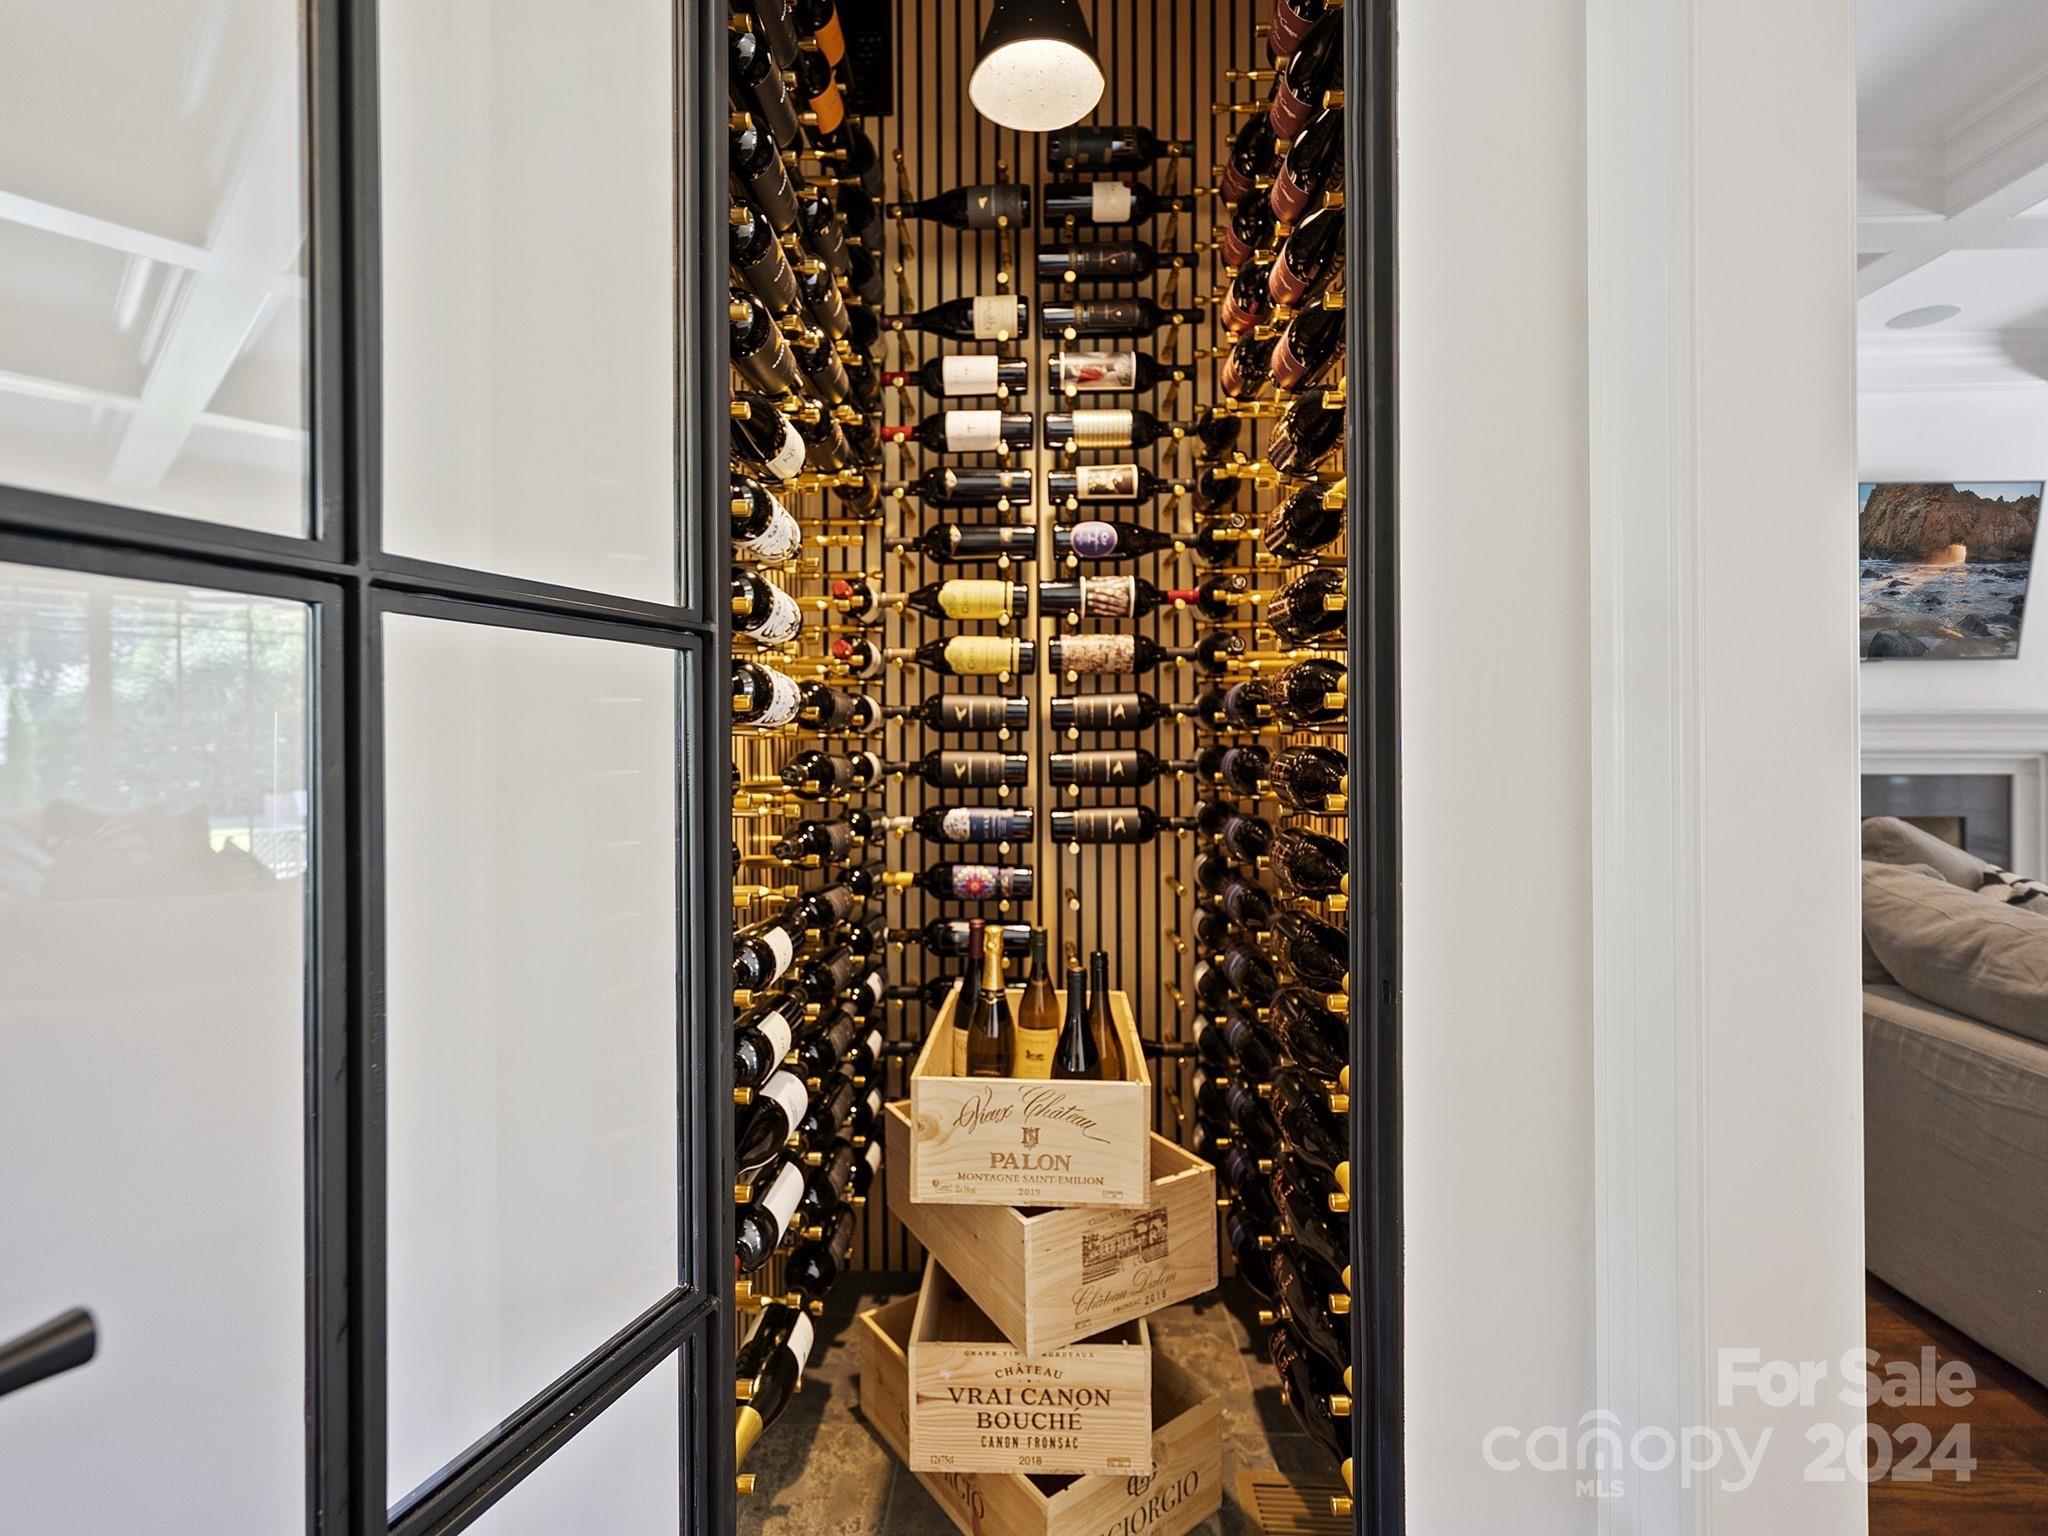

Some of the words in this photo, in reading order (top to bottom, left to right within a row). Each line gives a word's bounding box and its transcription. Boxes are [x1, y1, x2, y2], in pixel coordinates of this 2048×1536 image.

[990, 1152, 1072, 1171] PALON
[957, 1172, 1019, 1183] MONTAGNE
[1022, 1175, 1105, 1185] SAINT-EMILION
[994, 1363, 1064, 1380] CHÂTEAU
[948, 1387, 1012, 1405] VRAI
[1020, 1388, 1111, 1407] CANON
[976, 1407, 1083, 1430] BOUCHÉ
[981, 1436, 1019, 1449] CANON
[1027, 1436, 1079, 1450] FRONSAC
[1018, 1456, 1042, 1465] 2018
